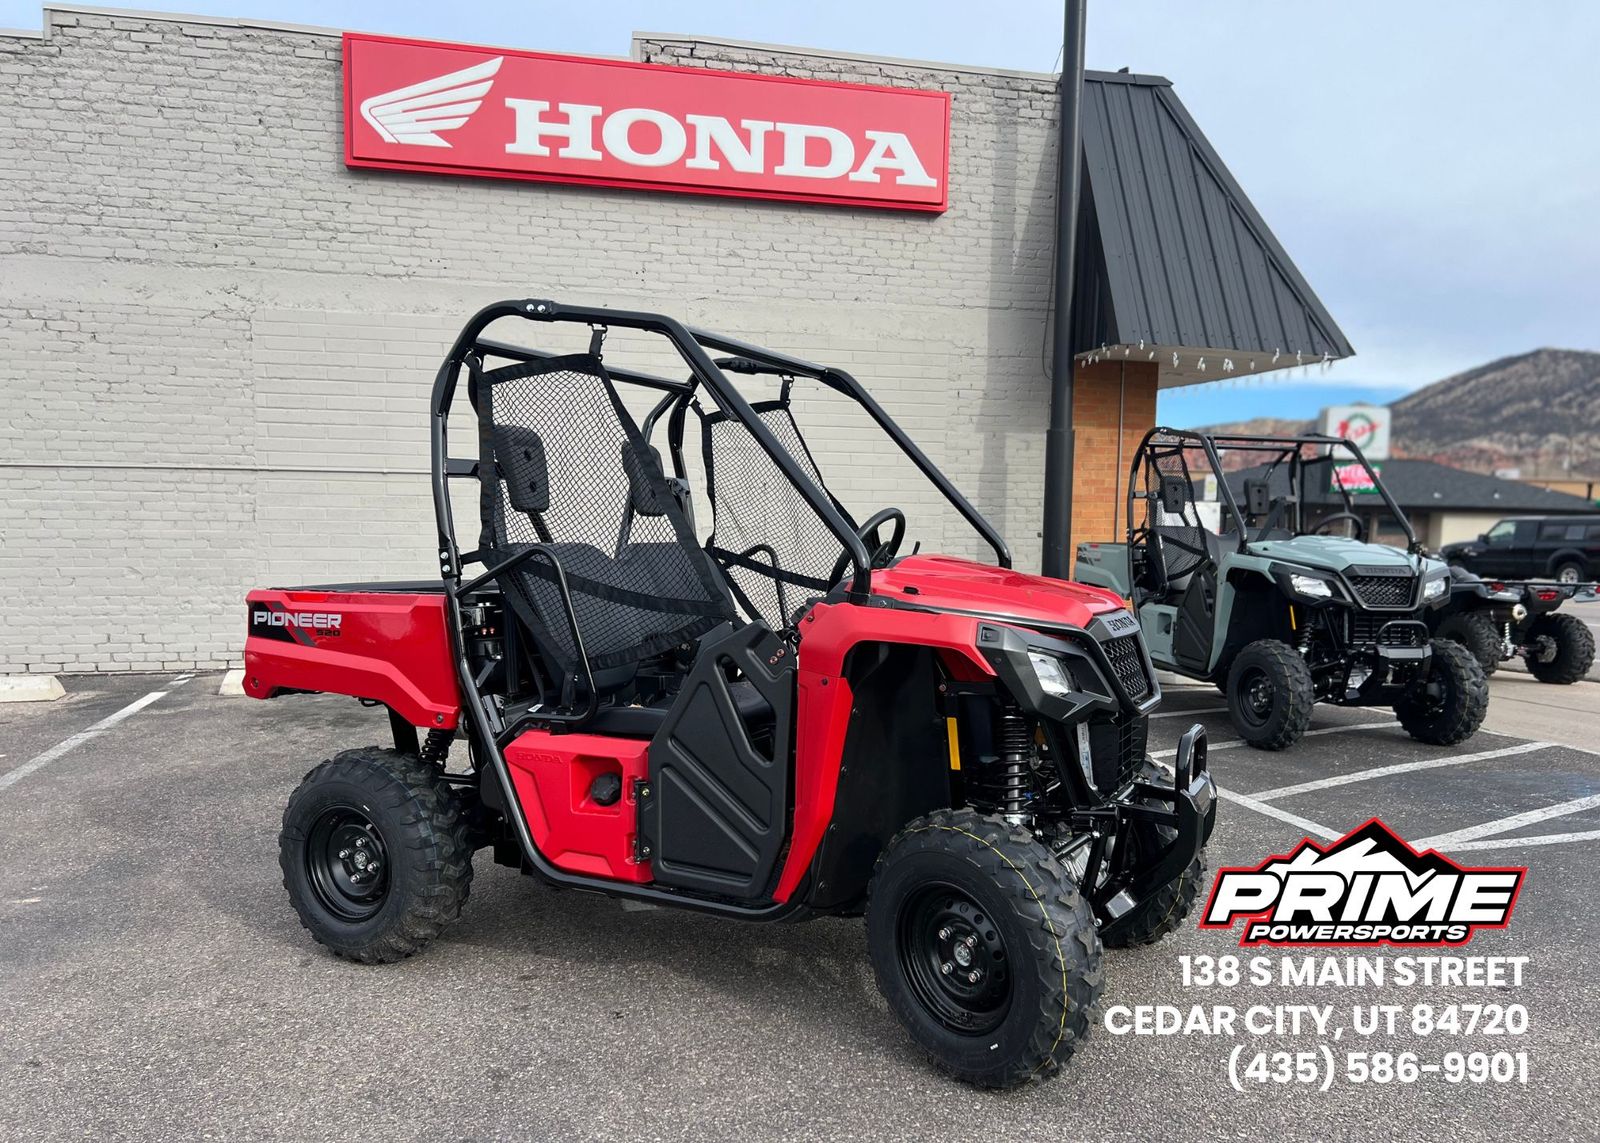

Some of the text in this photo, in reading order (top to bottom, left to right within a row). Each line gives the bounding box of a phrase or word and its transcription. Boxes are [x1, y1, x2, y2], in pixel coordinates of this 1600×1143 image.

[504, 97, 938, 188] HONDA
[253, 611, 342, 628] PIONEER
[316, 629, 341, 637] 520
